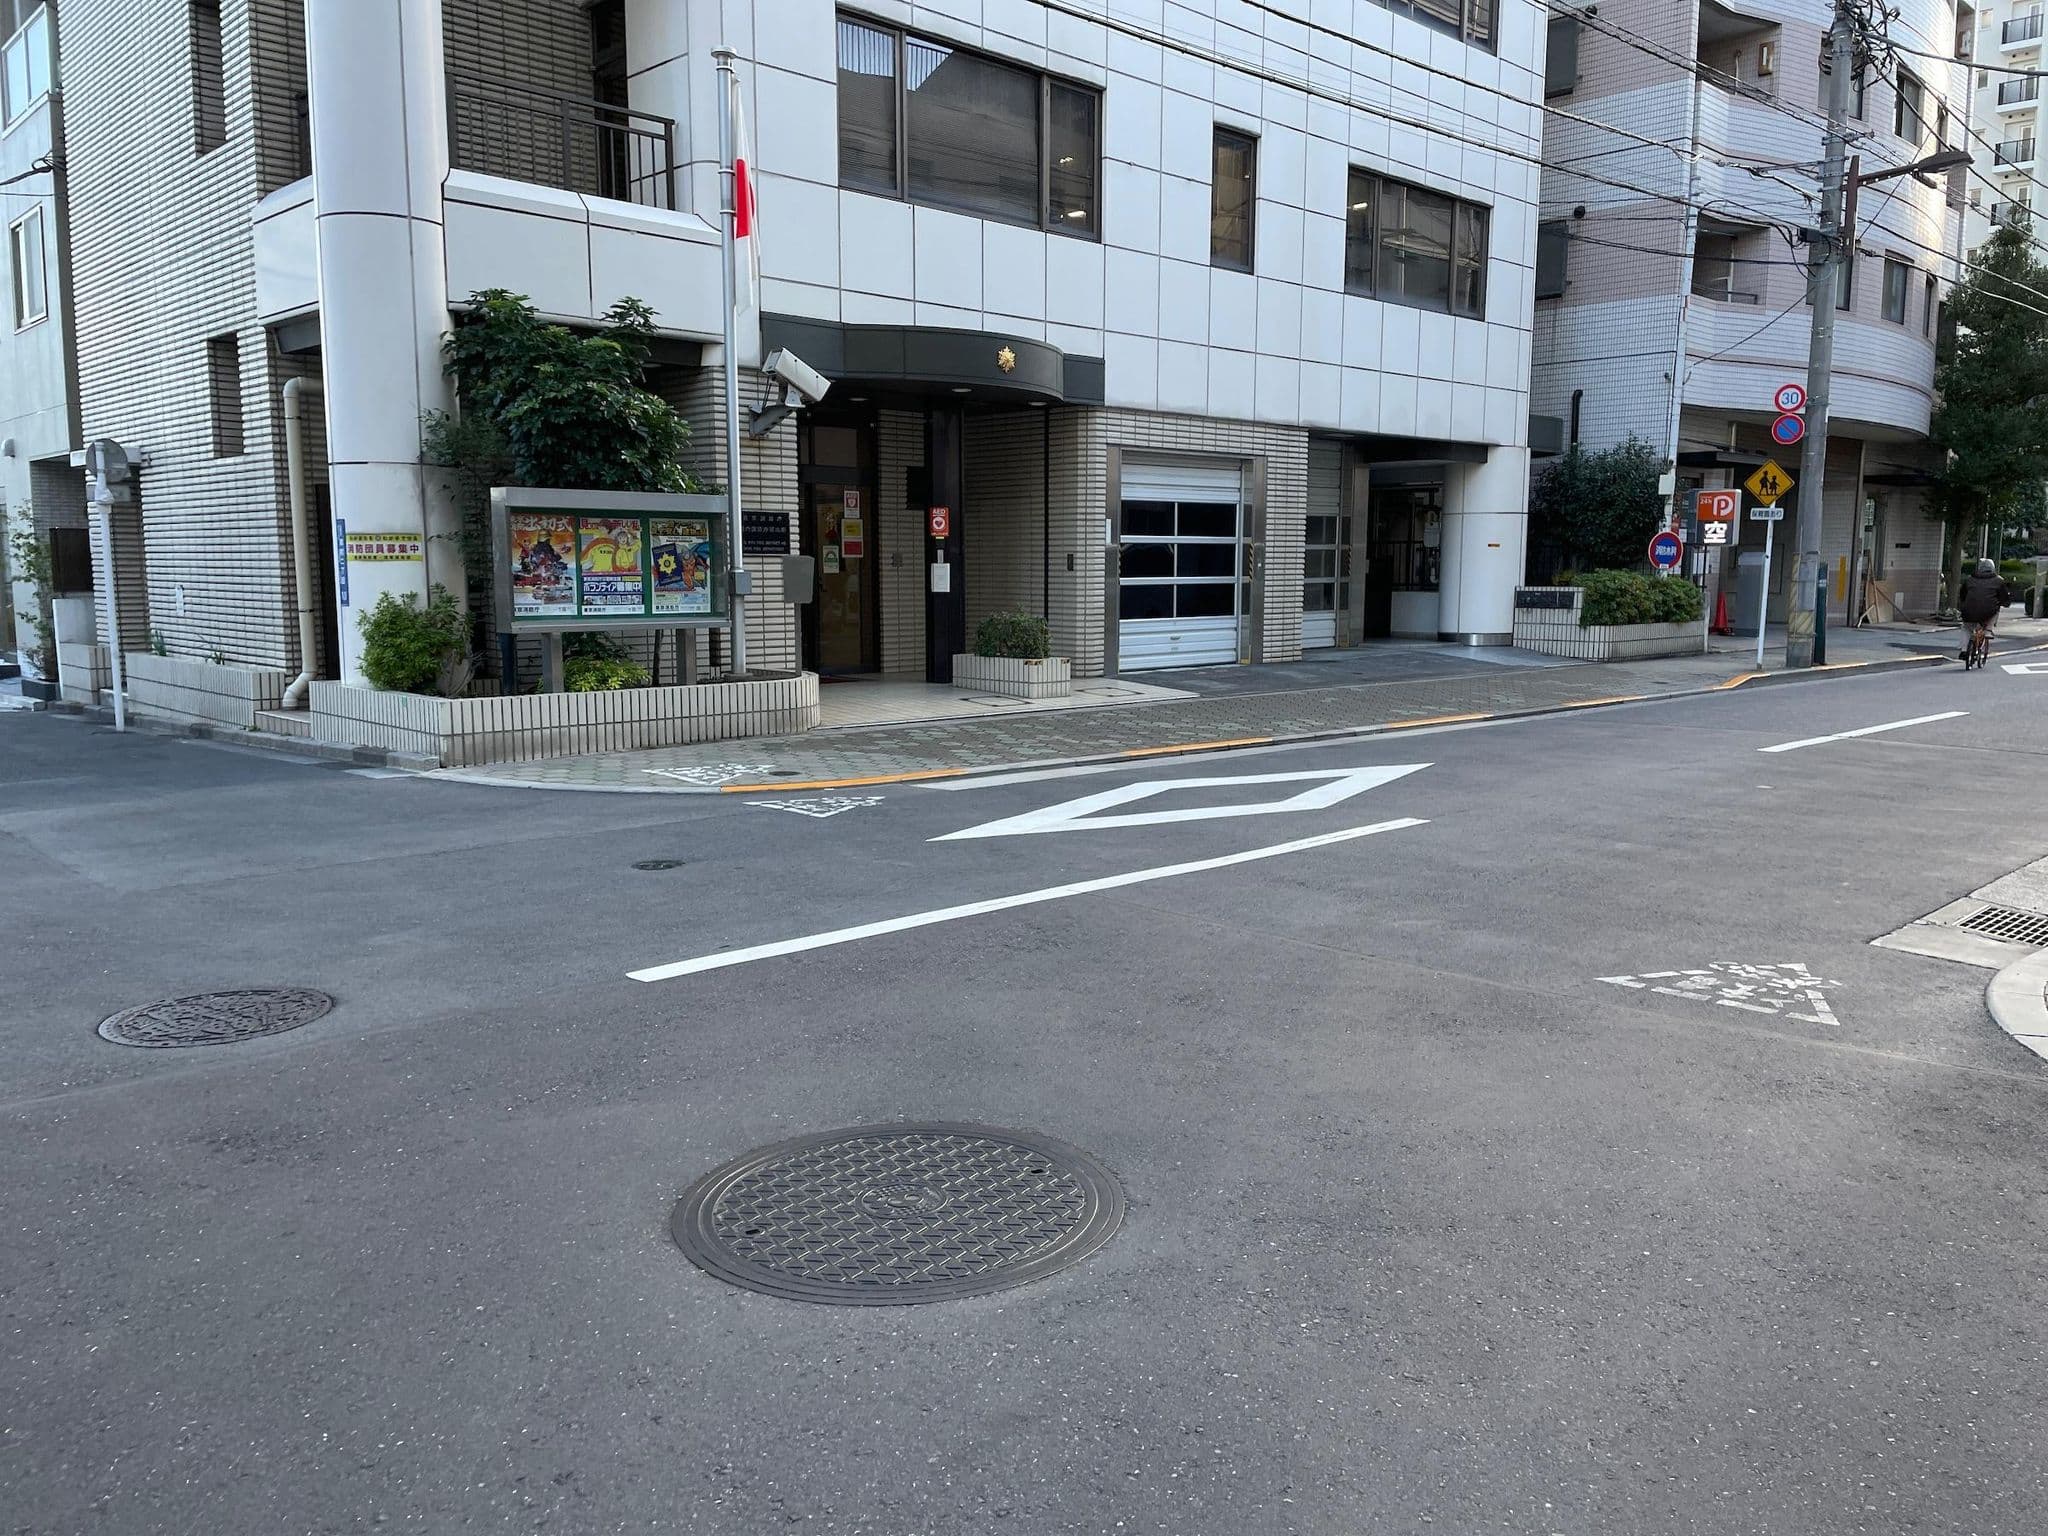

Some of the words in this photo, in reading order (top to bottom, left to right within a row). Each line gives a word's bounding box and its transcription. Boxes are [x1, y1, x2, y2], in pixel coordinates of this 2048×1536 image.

[1781, 391, 1799, 405] 30
[1713, 495, 1733, 517] P
[1703, 520, 1728, 544] 空
[347, 543, 419, 554] 消防団員募集中
